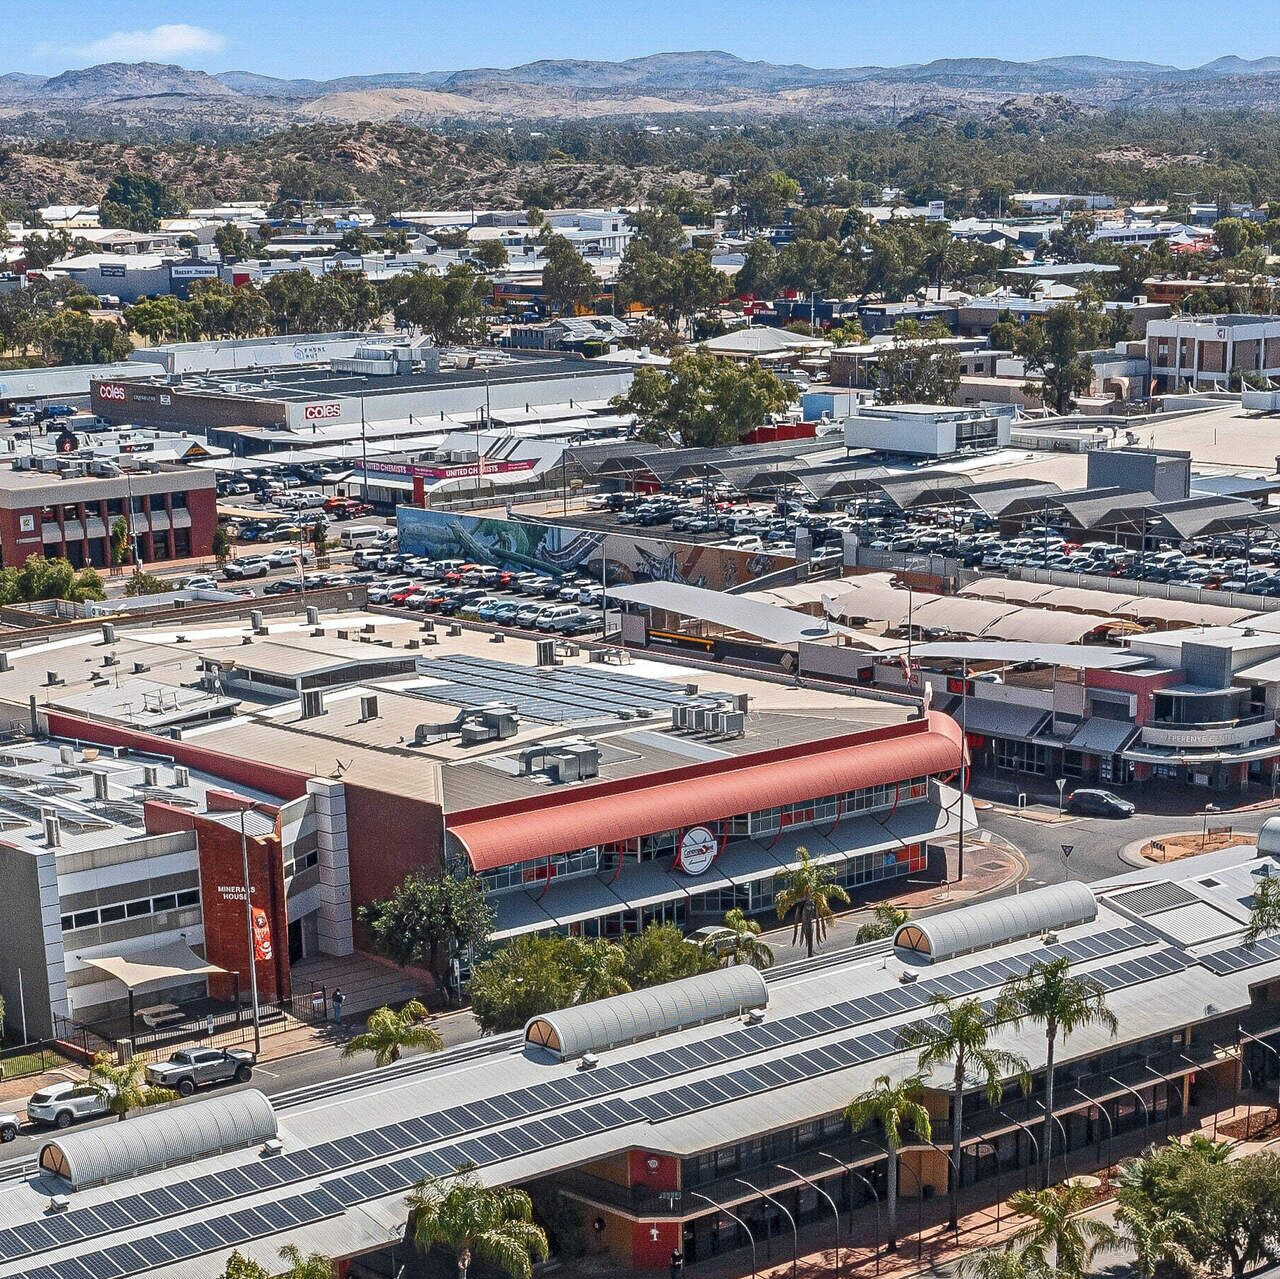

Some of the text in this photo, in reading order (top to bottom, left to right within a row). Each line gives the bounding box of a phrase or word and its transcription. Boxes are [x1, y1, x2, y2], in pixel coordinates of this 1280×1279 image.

[99, 384, 125, 400] coles
[306, 404, 341, 419] coles
[446, 469, 467, 477] UNITED
